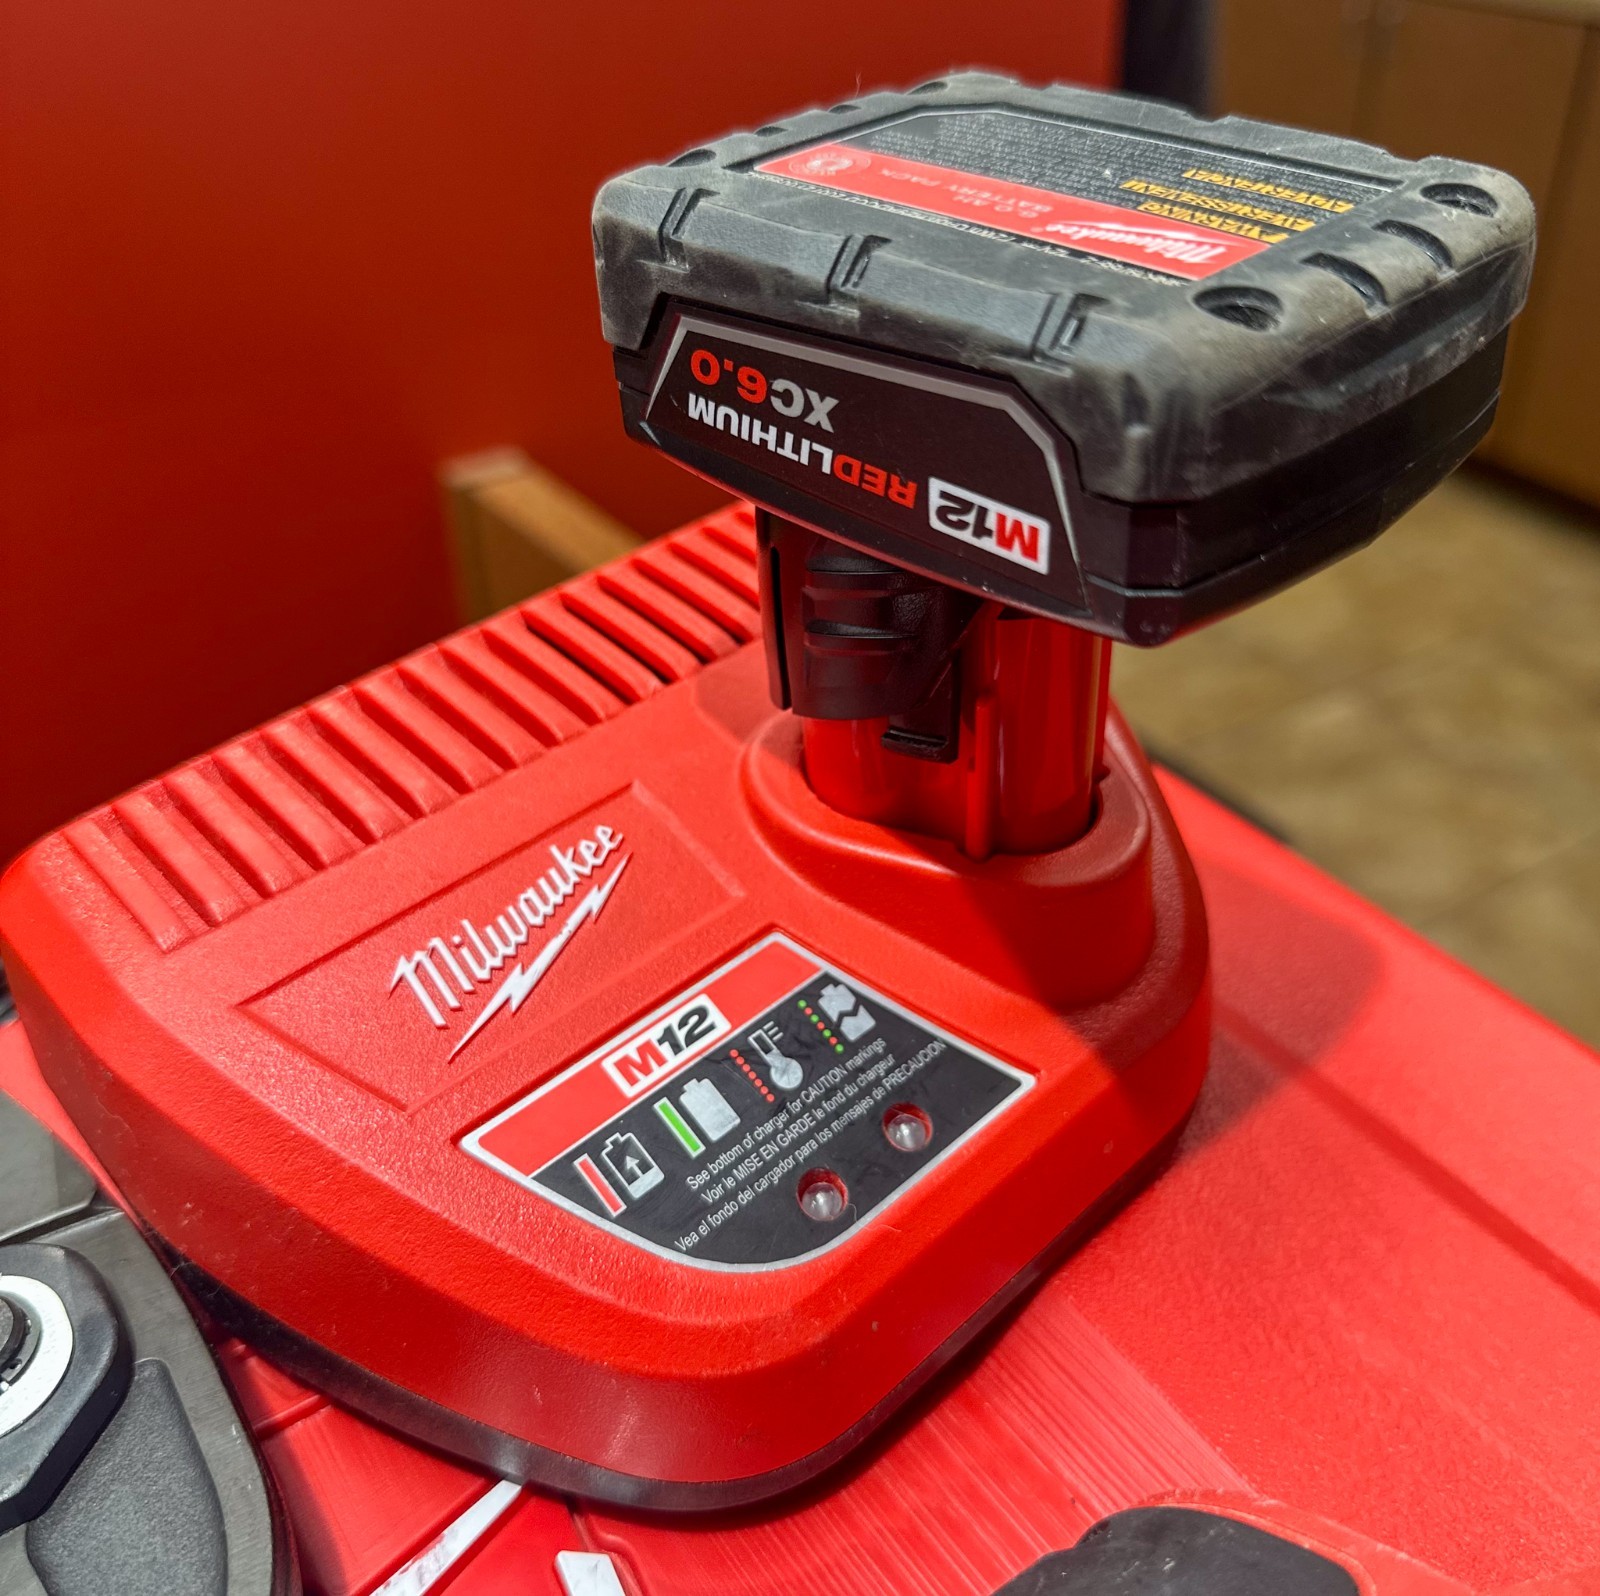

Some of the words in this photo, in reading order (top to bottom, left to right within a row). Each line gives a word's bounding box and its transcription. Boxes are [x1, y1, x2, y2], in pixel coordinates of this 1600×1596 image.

[881, 167, 940, 187] PACK
[945, 183, 1053, 213] BATTERY
[1122, 179, 1313, 231] AVERTISSEMENT
[1184, 169, 1352, 212] ADVERTENCIA
[1046, 221, 1227, 264] Milwaukee
[1140, 202, 1262, 239] WARNING
[690, 349, 839, 433] XC6.0
[688, 392, 917, 508] REDLITHIUM
[935, 493, 1040, 563] M12
[388, 825, 623, 1028] Milwaukee
[613, 1004, 717, 1087] M12
[686, 1167, 711, 1190] See
[711, 1143, 744, 1175] bottom
[743, 1134, 755, 1154] of
[753, 1110, 789, 1141] charger
[787, 1099, 803, 1118] for
[801, 1067, 847, 1104] CAUTION
[846, 1037, 886, 1073] markings
[702, 1182, 725, 1205] Voir
[724, 1169, 736, 1189] le
[735, 1152, 763, 1182] MISE
[761, 1142, 779, 1162] EN
[776, 1114, 817, 1151] GARDE
[815, 1106, 826, 1124] le
[822, 1090, 844, 1117] fond
[842, 1078, 859, 1098] du
[858, 1055, 895, 1086] chargeur
[675, 1229, 699, 1252] Vea
[698, 1219, 711, 1237] el
[708, 1197, 739, 1230] fondo
[737, 1182, 754, 1206] del
[754, 1158, 796, 1193] cargador
[796, 1139, 818, 1164] para
[817, 1127, 833, 1149] los
[831, 1099, 873, 1135] mensajes
[872, 1083, 886, 1104] de
